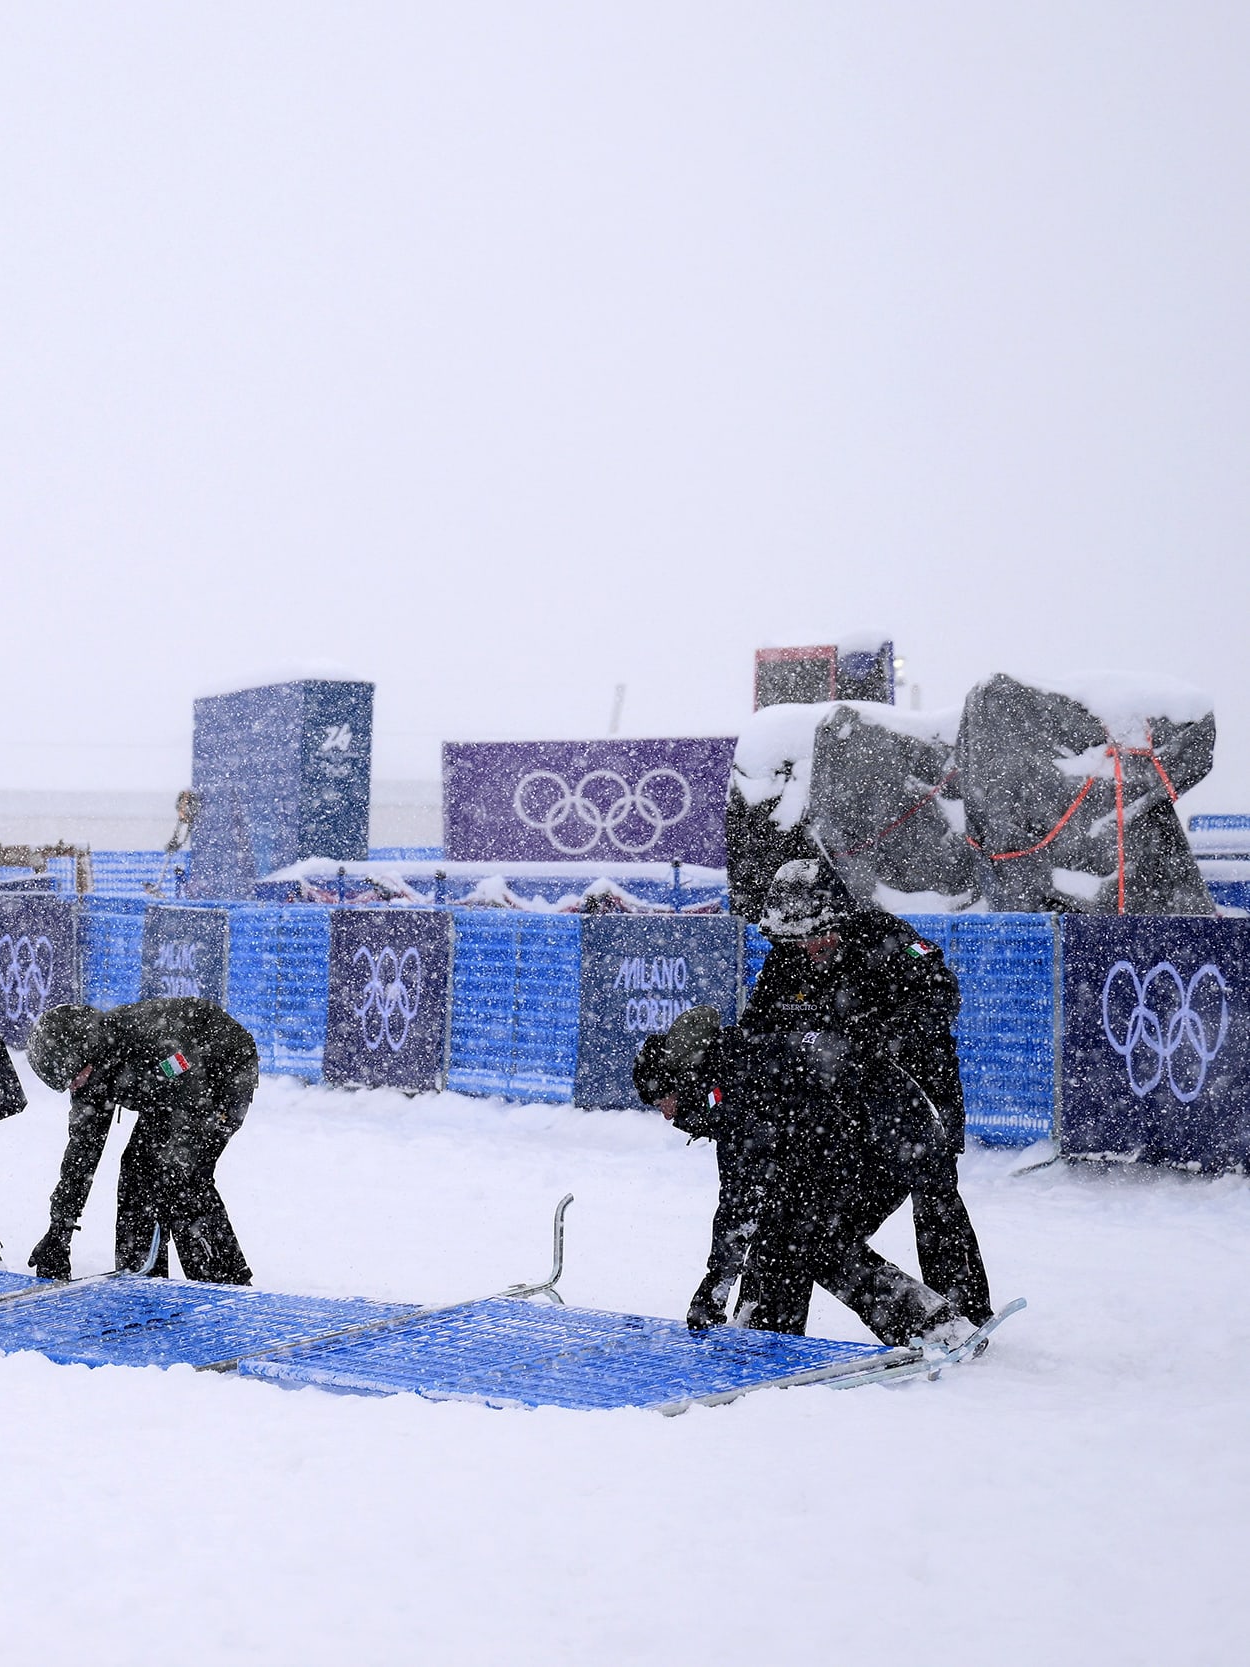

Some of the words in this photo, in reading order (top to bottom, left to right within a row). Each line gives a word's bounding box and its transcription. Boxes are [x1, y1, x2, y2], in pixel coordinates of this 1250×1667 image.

[613, 956, 687, 991] MILANO
[626, 998, 694, 1032] CORTIN
[782, 1003, 818, 1011] ESERCITO
